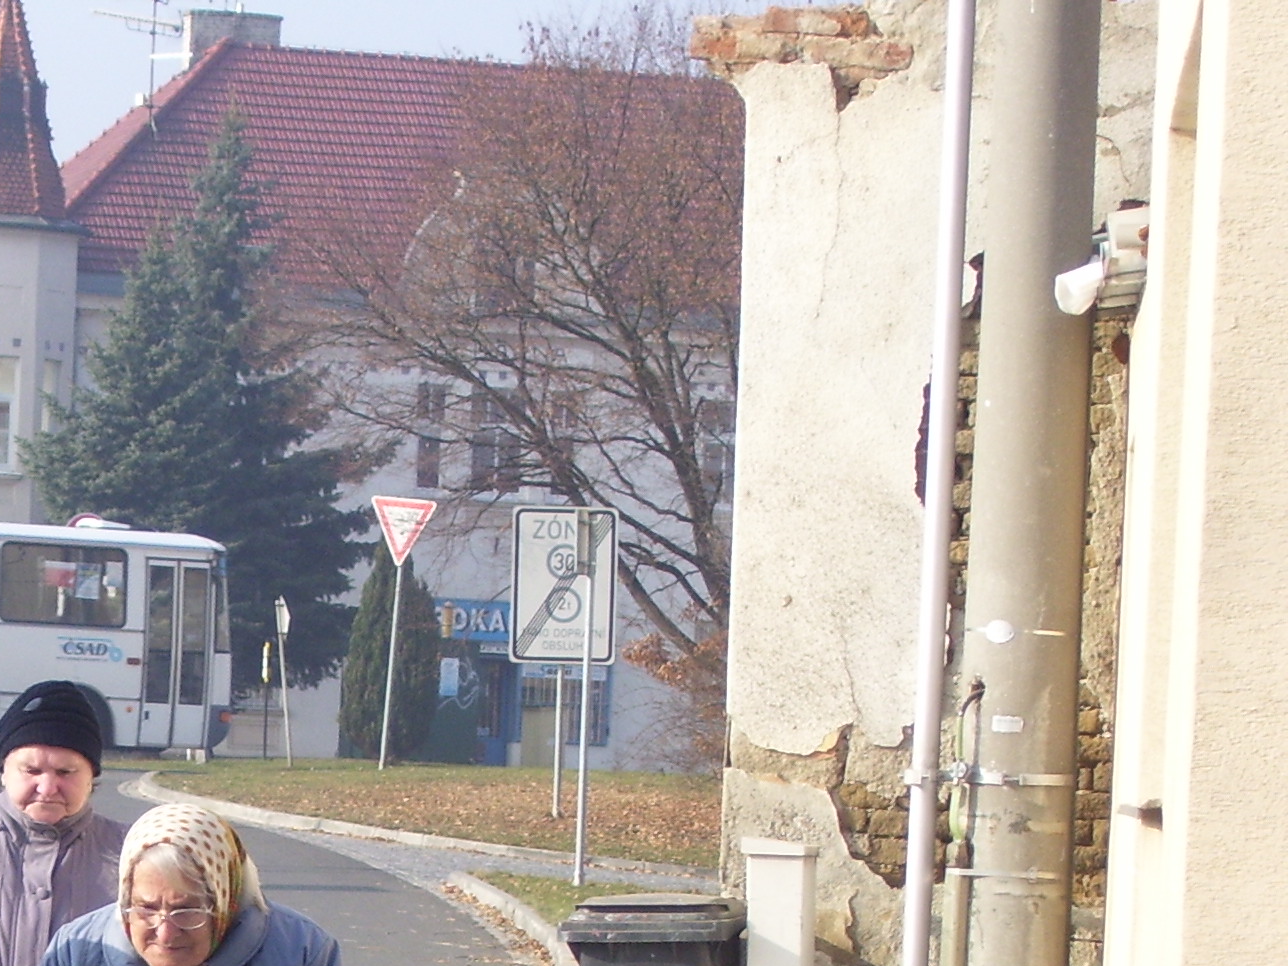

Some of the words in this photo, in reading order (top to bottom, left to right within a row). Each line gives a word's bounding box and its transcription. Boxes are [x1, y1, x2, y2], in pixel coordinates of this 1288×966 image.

[532, 514, 576, 540] ZÓN
[553, 552, 576, 571] 30
[63, 637, 108, 656] ČSAD
